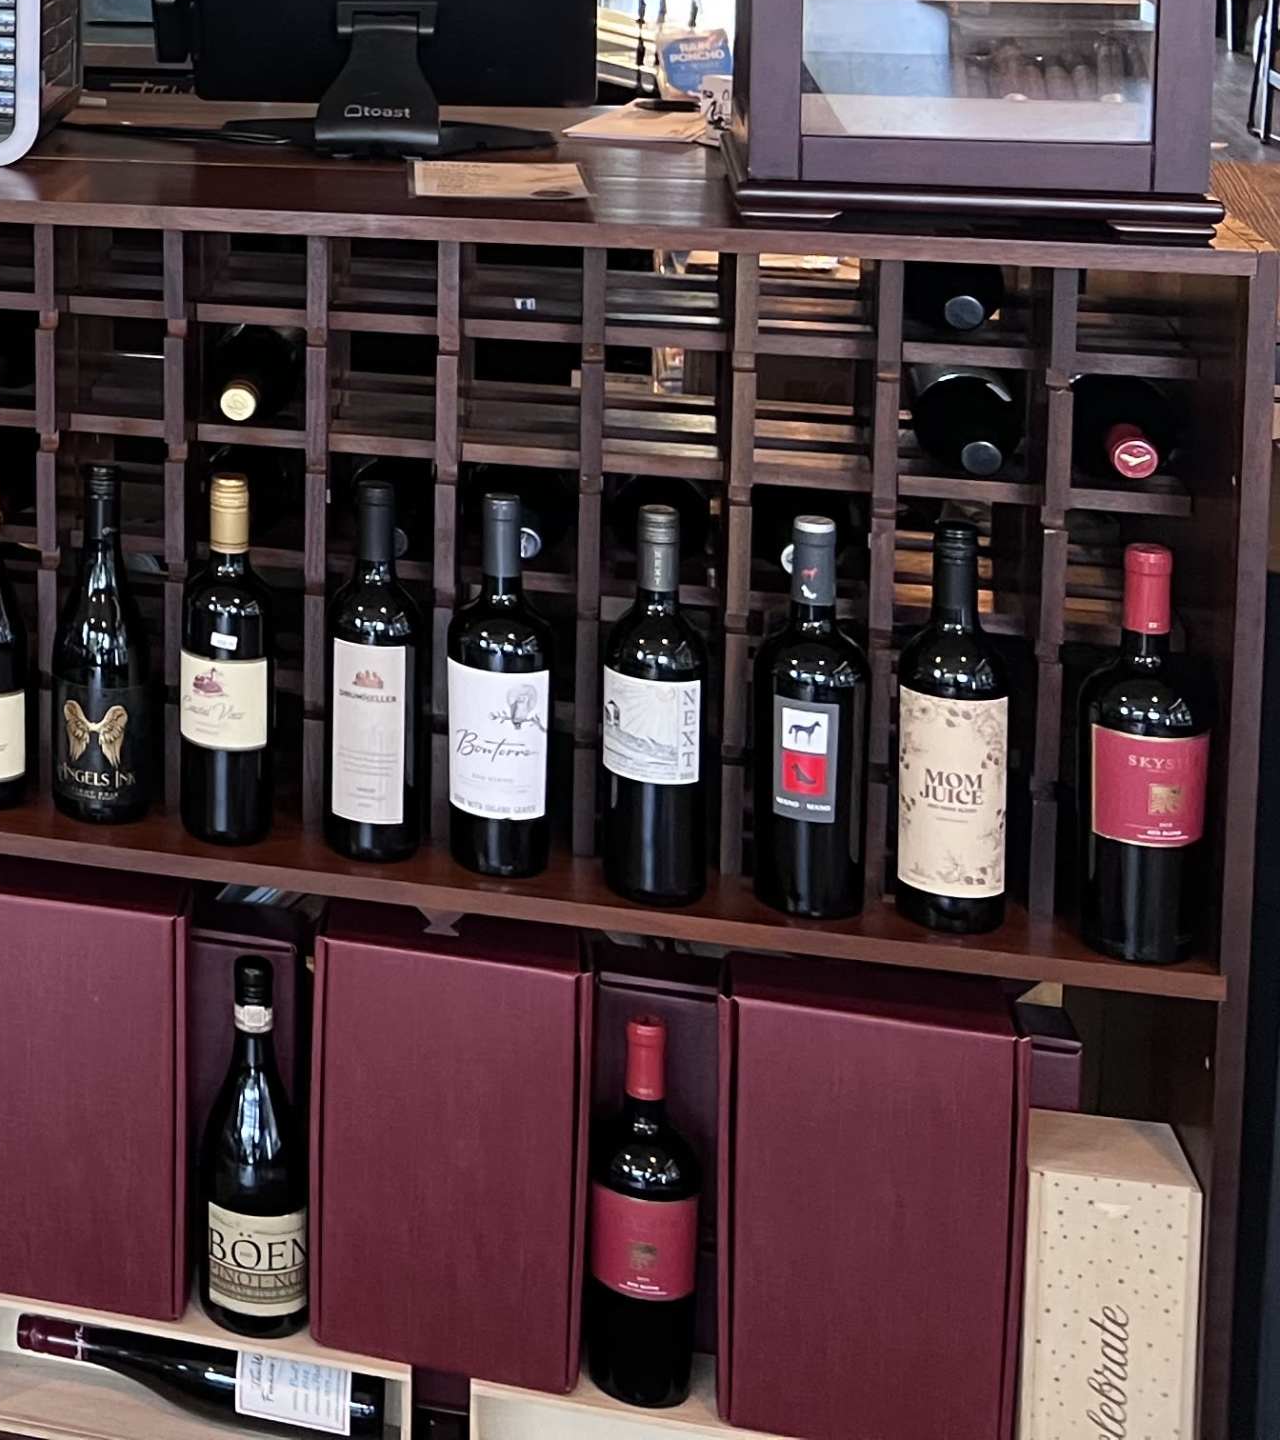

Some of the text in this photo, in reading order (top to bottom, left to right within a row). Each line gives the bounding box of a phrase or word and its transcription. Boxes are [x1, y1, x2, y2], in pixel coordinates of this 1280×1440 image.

[669, 49, 727, 64] PONCHO
[361, 104, 412, 119] toast
[681, 688, 698, 768] NEXT
[456, 728, 539, 763] Bonterra
[925, 768, 984, 791] MOM
[919, 784, 985, 807] JUICE
[1086, 1302, 1131, 1440] lebrate
